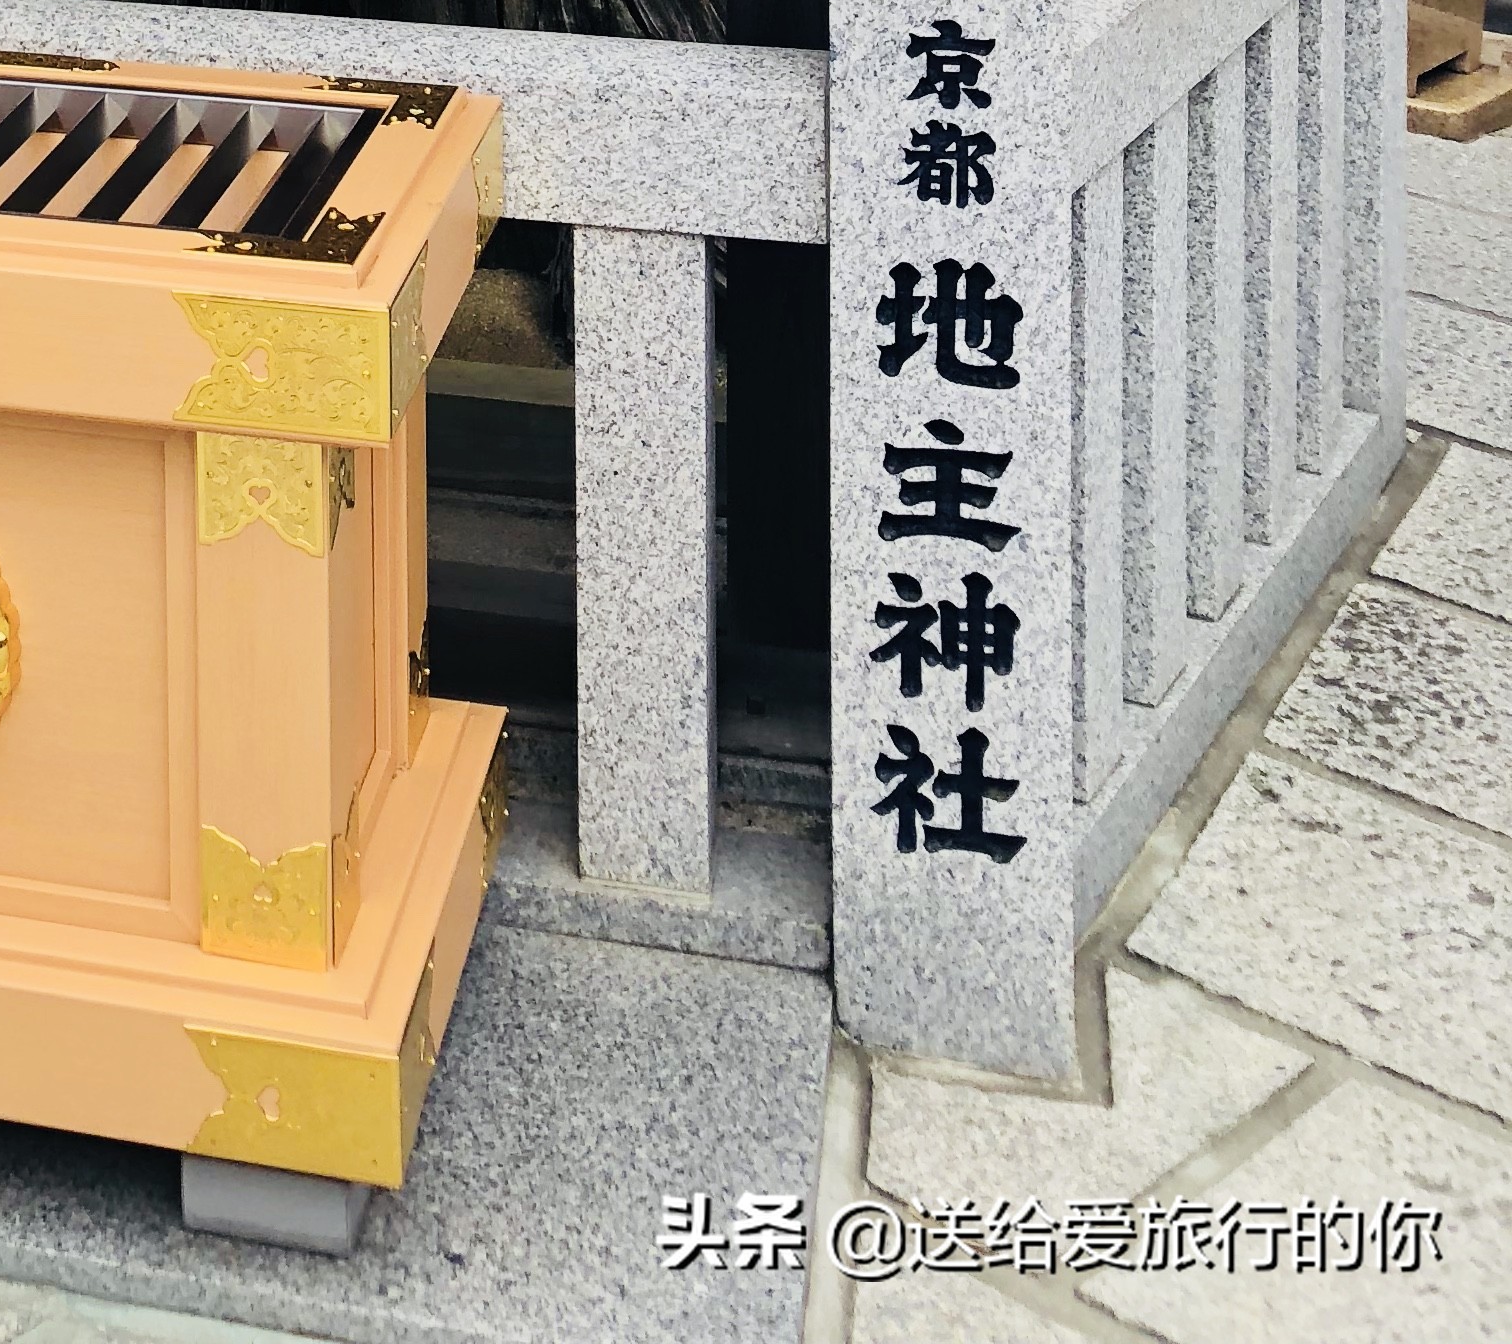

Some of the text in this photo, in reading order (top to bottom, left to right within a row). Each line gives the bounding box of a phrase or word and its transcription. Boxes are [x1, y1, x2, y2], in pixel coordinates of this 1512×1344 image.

[897, 19, 997, 208] 京都
[871, 259, 1029, 862] 地主神社
